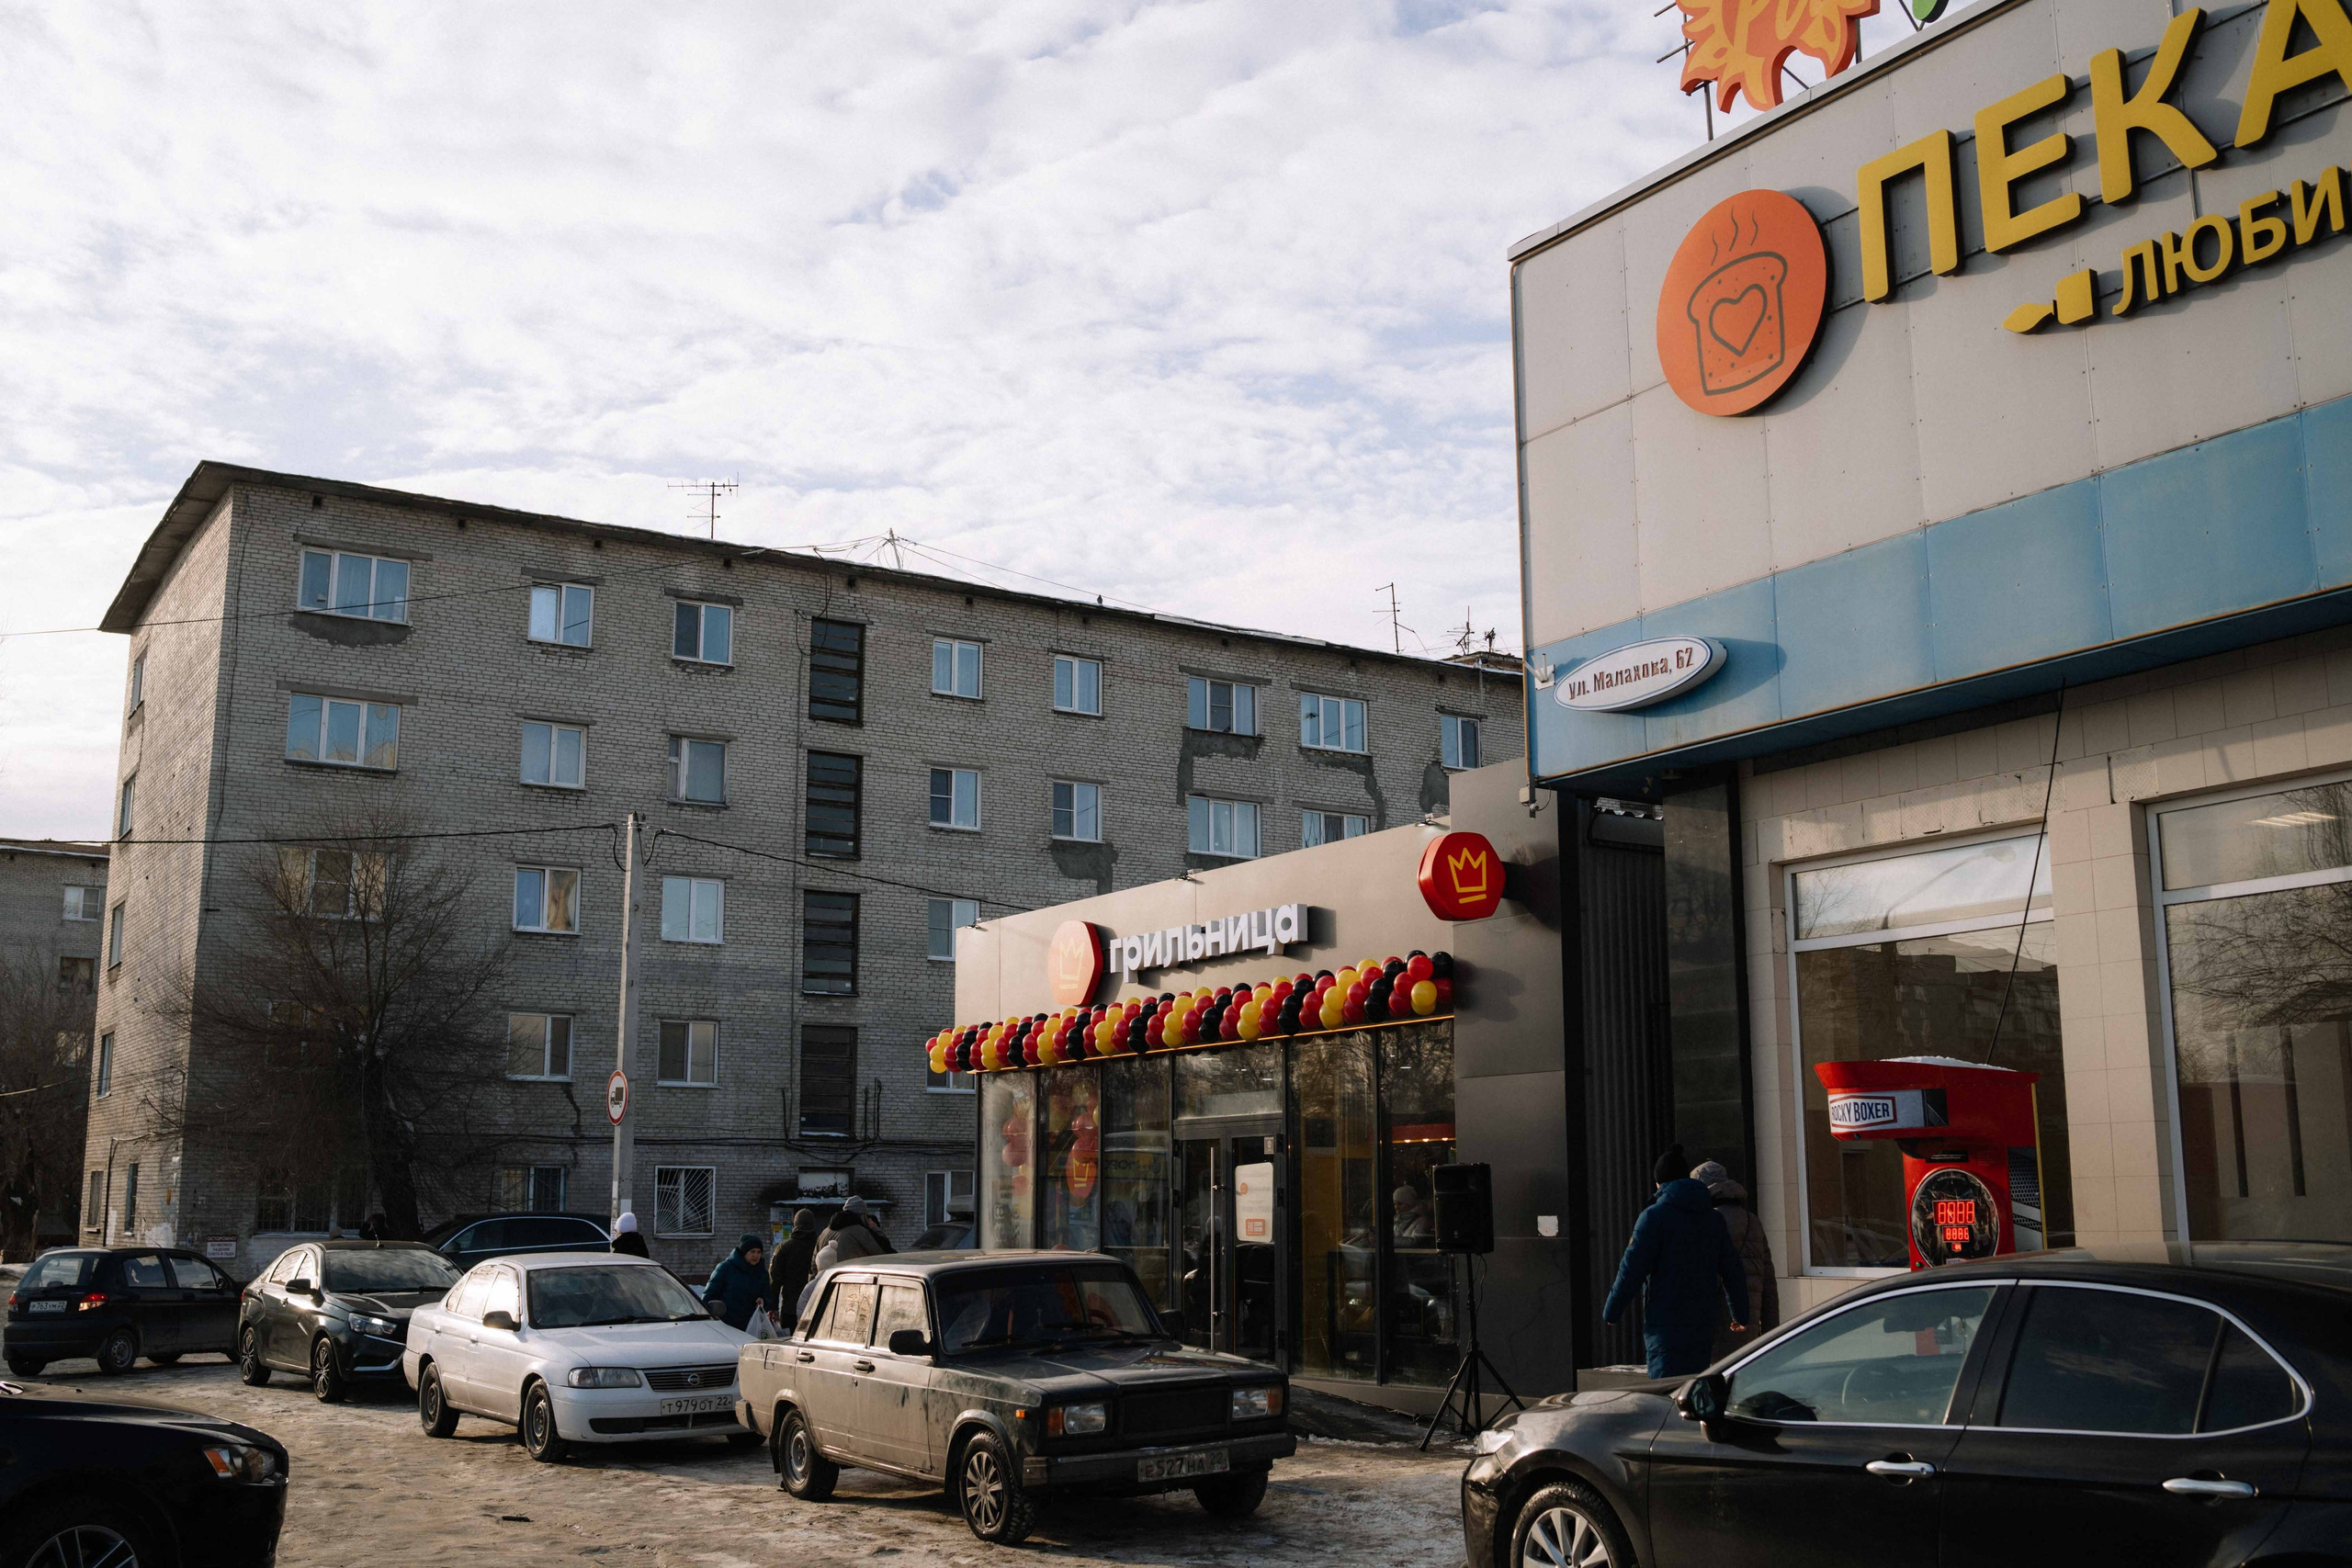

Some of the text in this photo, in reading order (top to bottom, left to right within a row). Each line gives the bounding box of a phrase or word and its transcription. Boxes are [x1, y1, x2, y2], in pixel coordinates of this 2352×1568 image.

[1857, 0, 2352, 303] ПЕКА
[2112, 162, 2352, 317] ЛЮБИ
[1568, 647, 1694, 700] ул. Малахова, 62
[1110, 903, 1307, 984] грильница
[1854, 1102, 1890, 1122] BOXER
